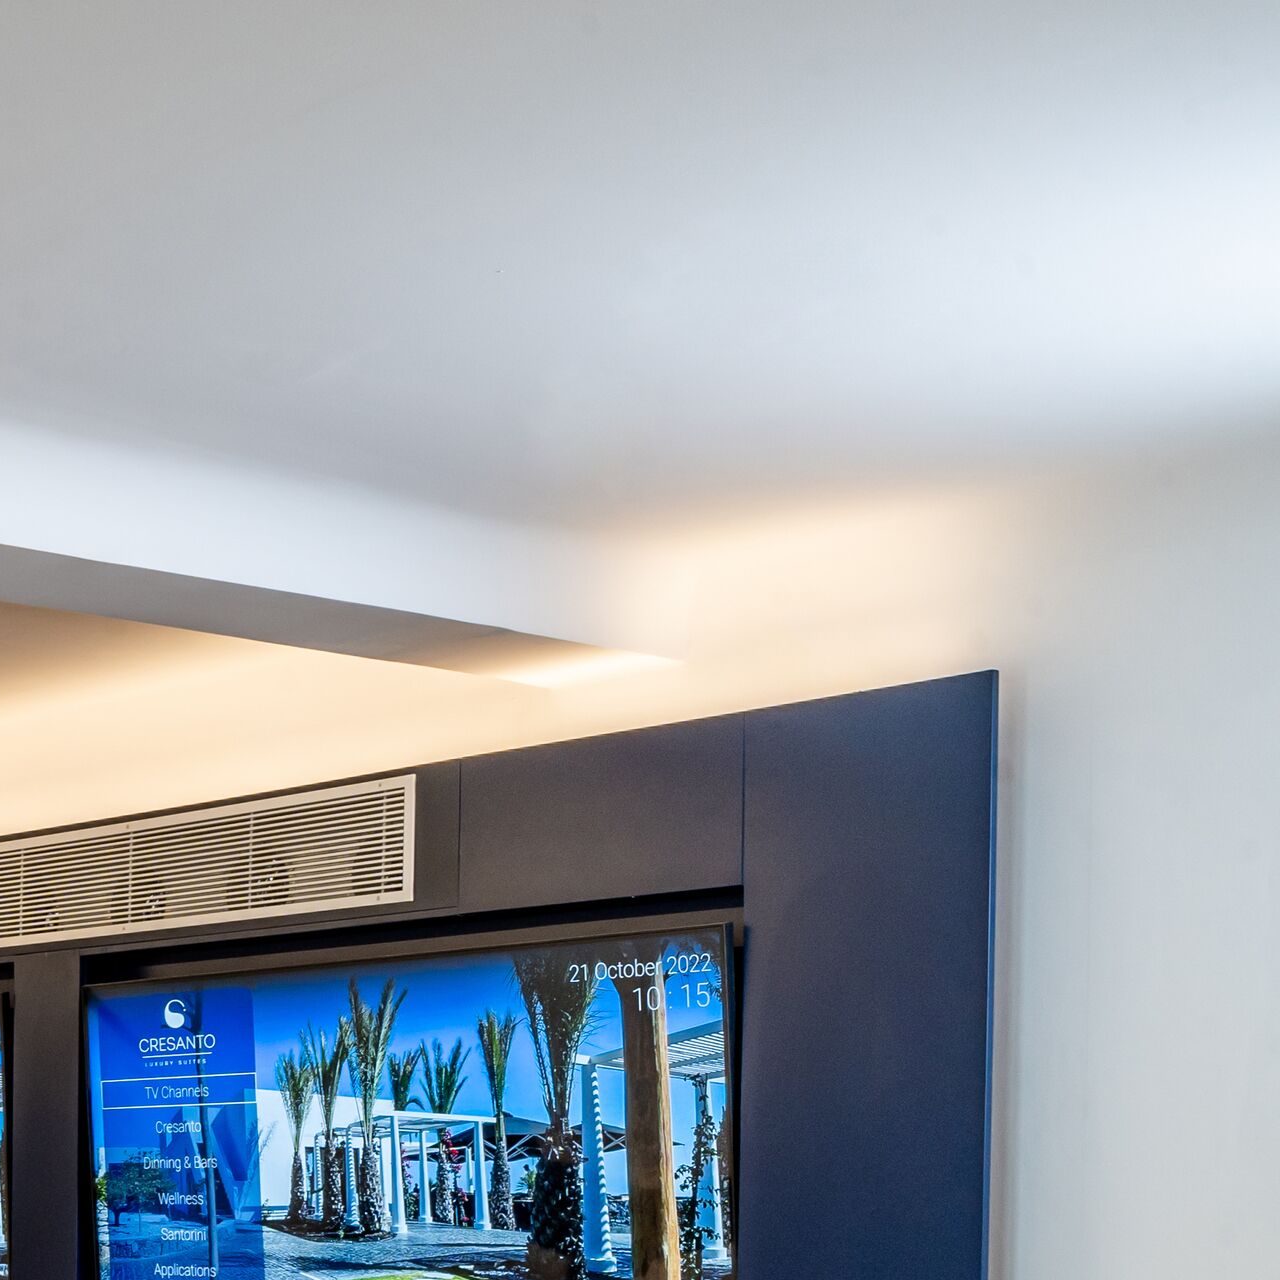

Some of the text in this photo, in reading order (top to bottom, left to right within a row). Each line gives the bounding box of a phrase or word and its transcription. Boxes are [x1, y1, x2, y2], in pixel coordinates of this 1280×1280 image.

[568, 953, 712, 983] 21 October 2022
[632, 986, 661, 1012] 10
[680, 982, 711, 1008] 15
[138, 1034, 216, 1053] CRESANTO
[144, 1085, 210, 1100] TV Channels
[155, 1121, 202, 1134] Cresanto
[143, 1155, 218, 1172] Dinning & Bars
[157, 1192, 205, 1206] Wellness
[160, 1227, 207, 1241] Santorini
[153, 1263, 217, 1279] Applications
